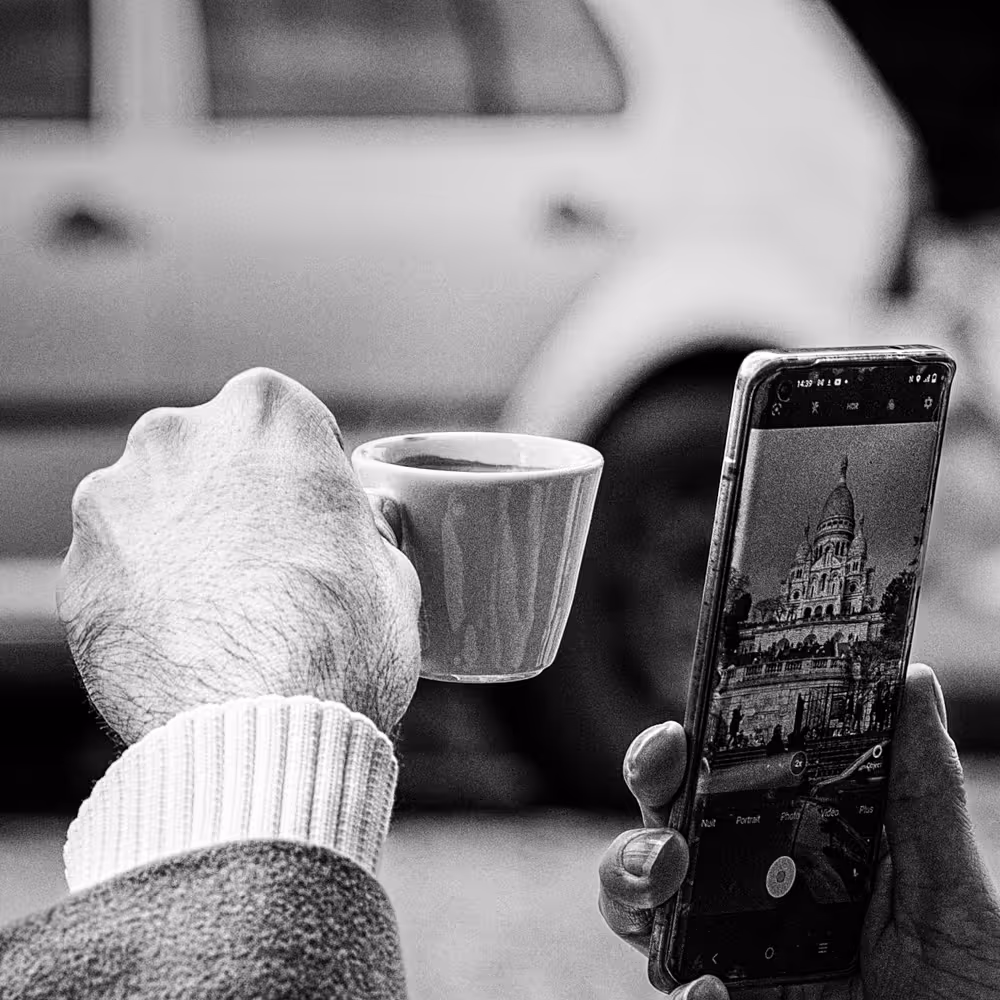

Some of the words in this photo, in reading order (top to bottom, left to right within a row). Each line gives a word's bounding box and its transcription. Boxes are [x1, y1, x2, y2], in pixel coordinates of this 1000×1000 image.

[858, 805, 874, 814] Plus
[735, 815, 761, 825] Portrait
[780, 811, 801, 821] Photo
[700, 818, 716, 828] Nuit
